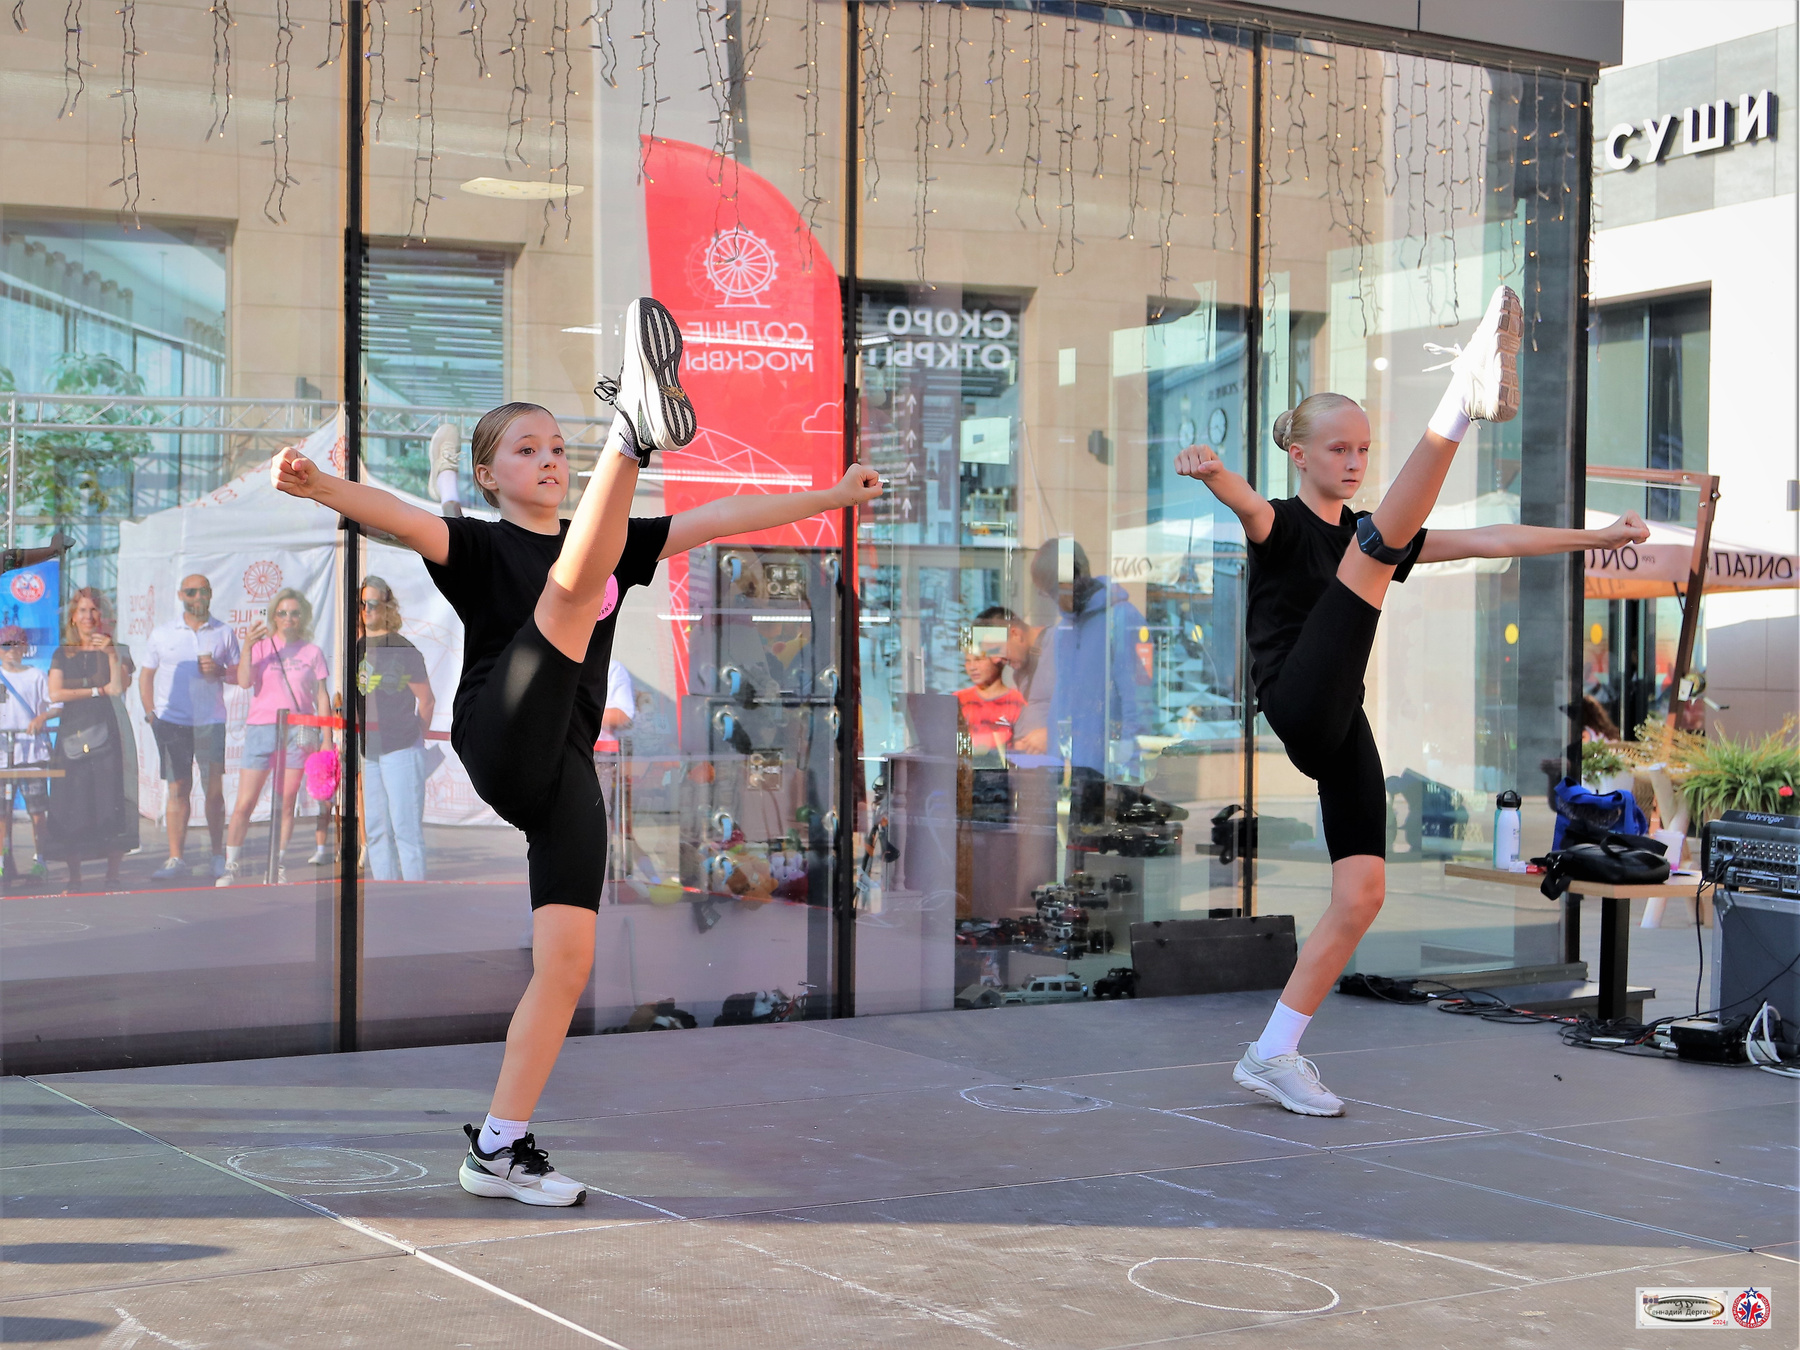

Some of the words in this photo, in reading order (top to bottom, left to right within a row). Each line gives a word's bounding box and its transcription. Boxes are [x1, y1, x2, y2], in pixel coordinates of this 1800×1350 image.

[1605, 89, 1771, 170] СУШИ
[1714, 552, 1793, 579] ПАТИО
[1745, 812, 1784, 824] behringer
